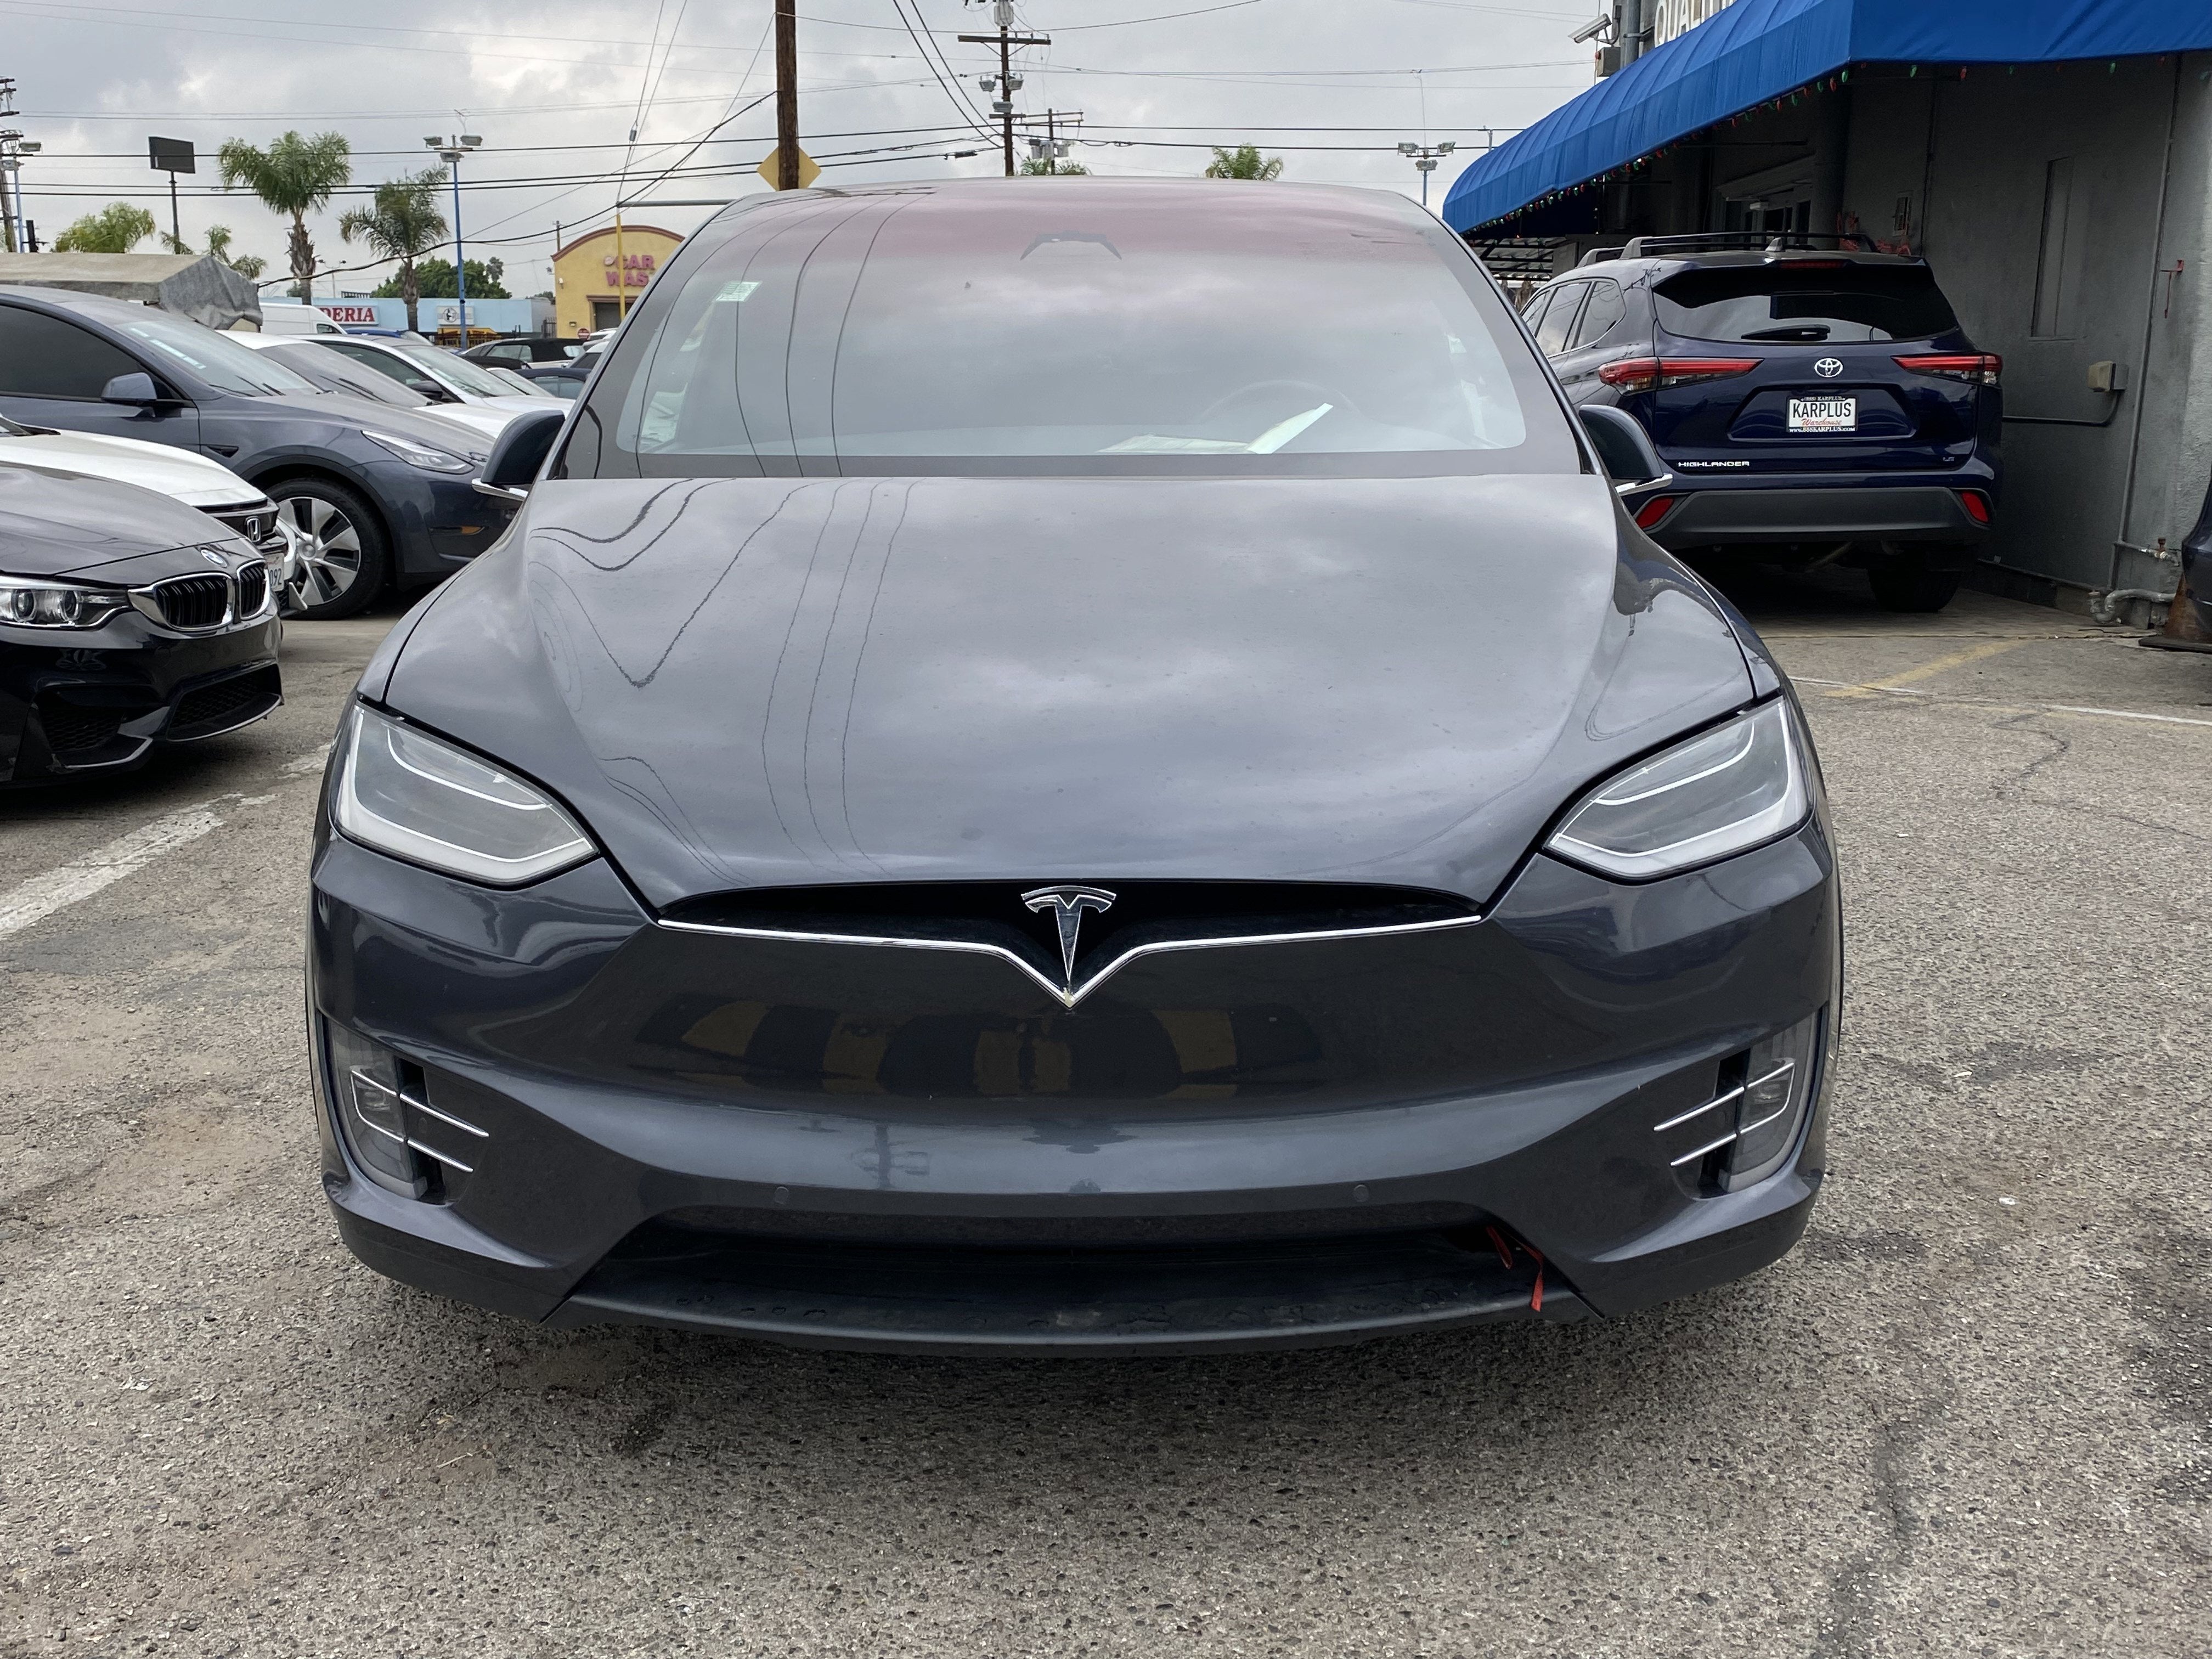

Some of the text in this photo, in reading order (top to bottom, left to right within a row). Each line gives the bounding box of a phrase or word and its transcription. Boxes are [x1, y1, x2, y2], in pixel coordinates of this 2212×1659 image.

[614, 255, 654, 269] CAR
[1792, 402, 1852, 417] KARPLUS
[1801, 417, 1842, 426] Warehouse
